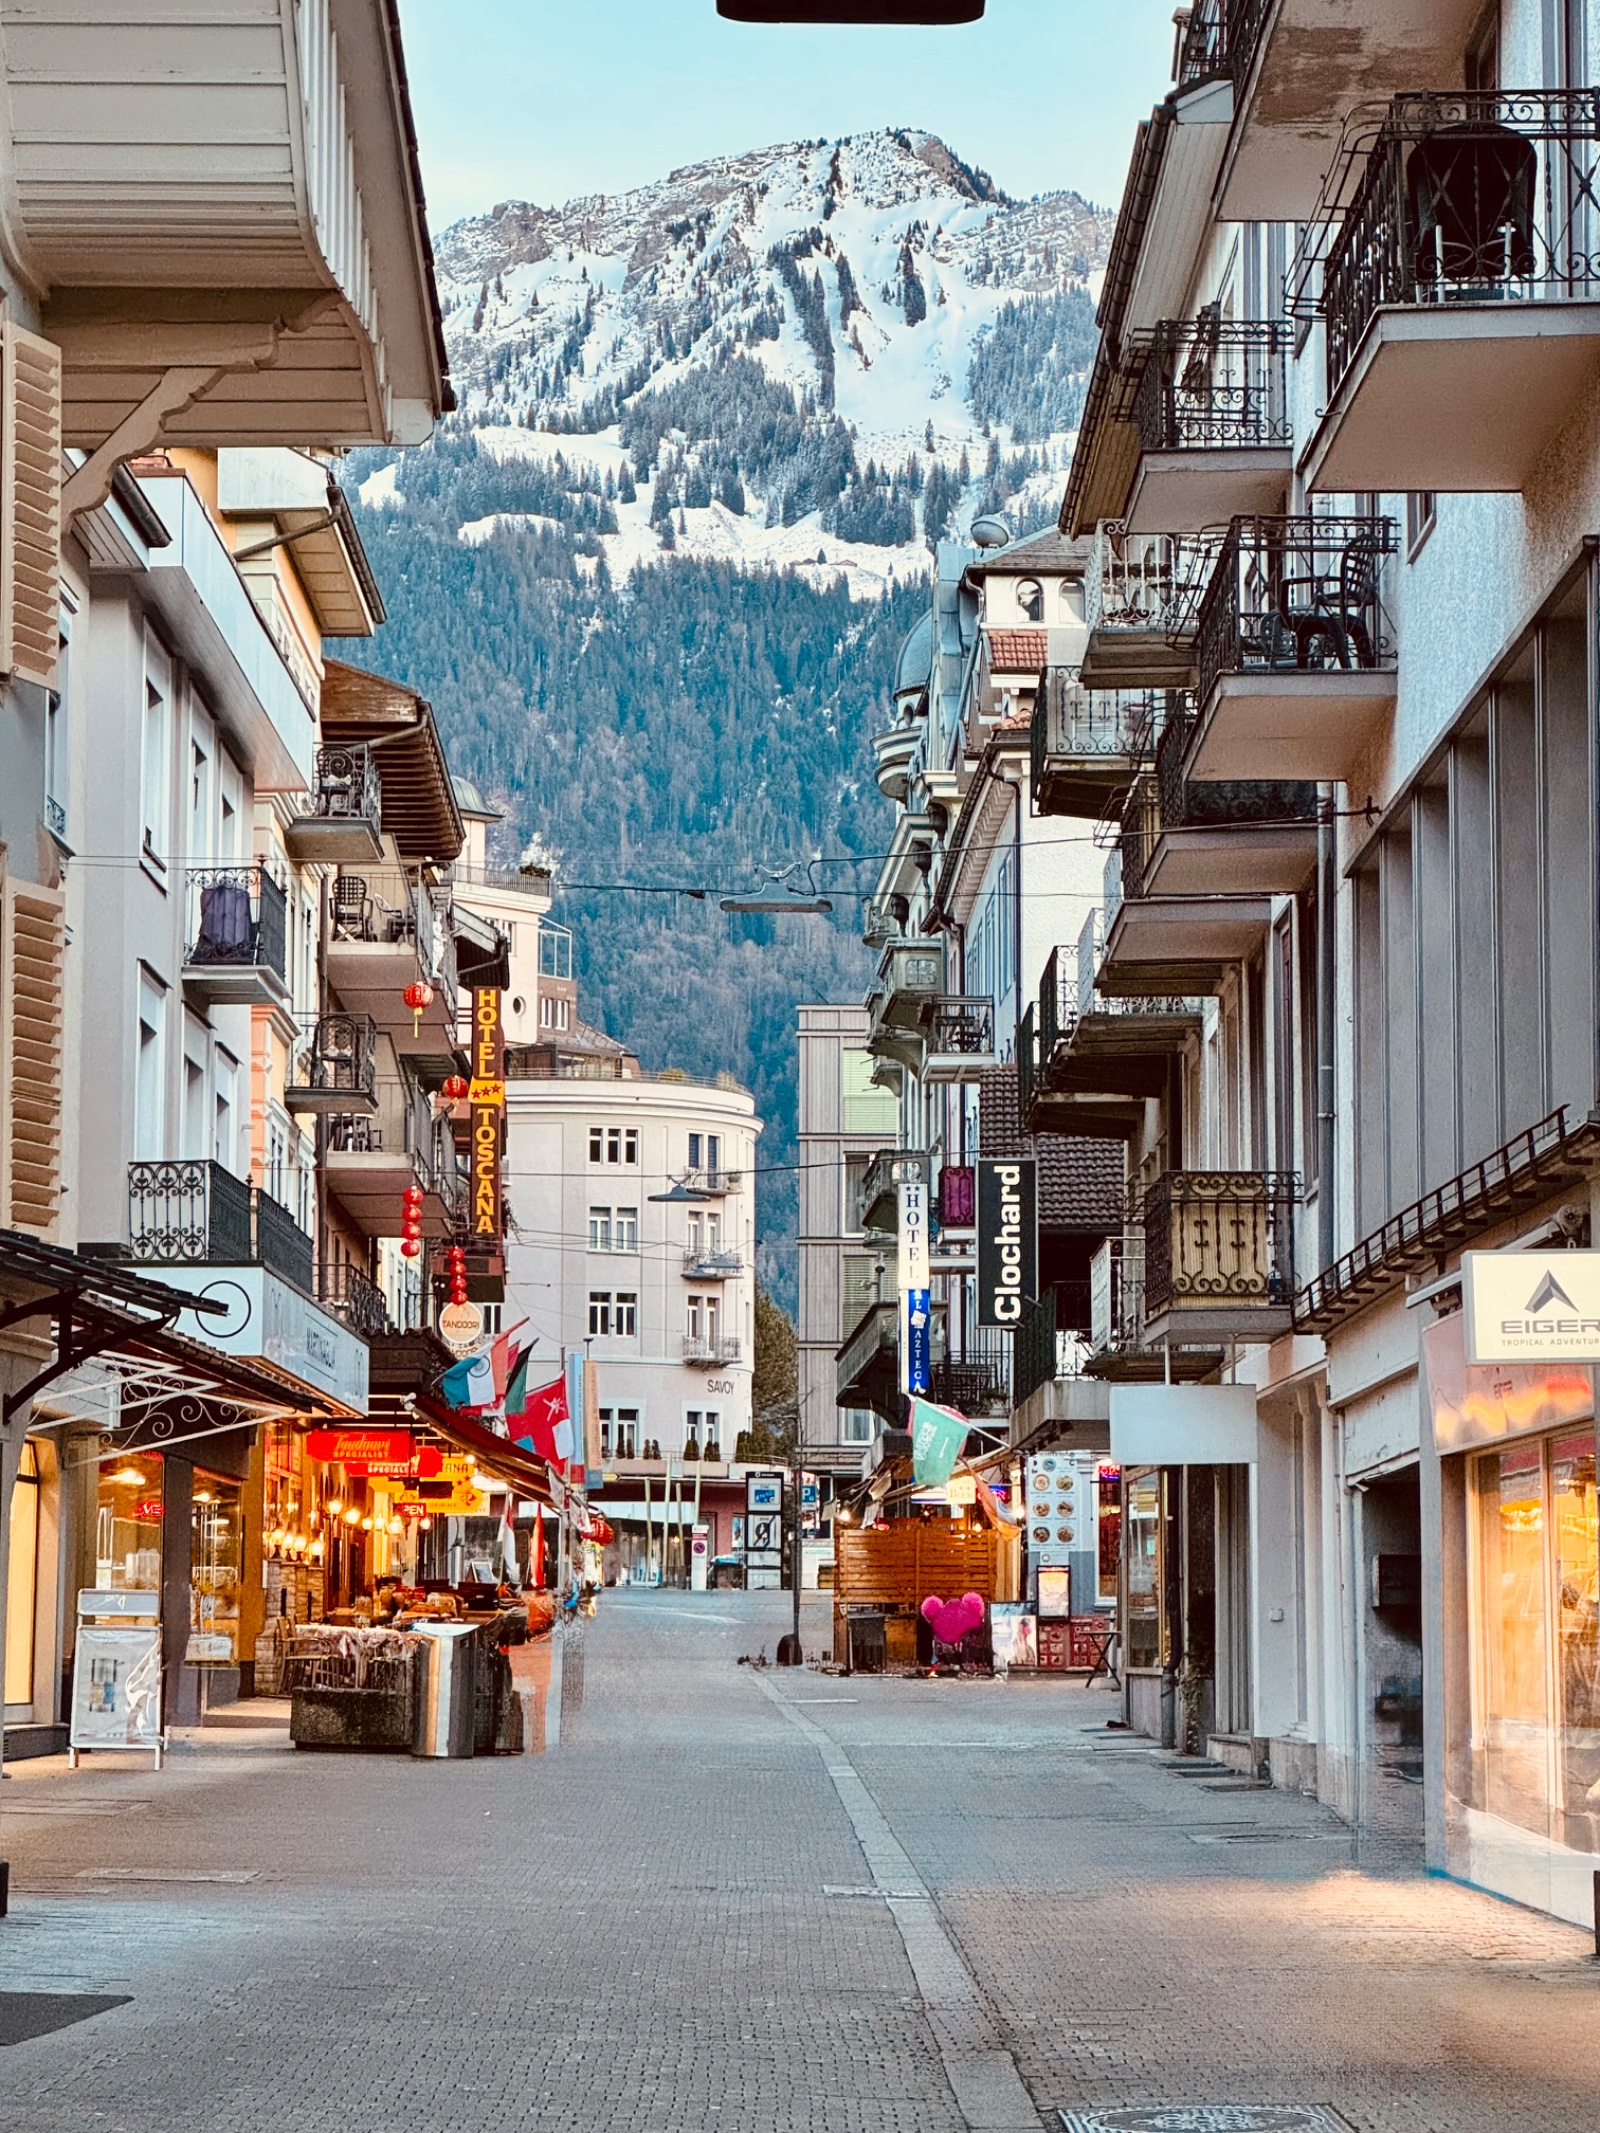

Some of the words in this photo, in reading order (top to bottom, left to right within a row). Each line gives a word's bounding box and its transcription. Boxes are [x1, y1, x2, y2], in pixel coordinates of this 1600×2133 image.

[477, 989, 498, 1078] HOTEL
[476, 1108, 497, 1234] TOSCANA
[906, 1194, 920, 1279] HOTEL
[994, 1165, 1021, 1321] Clochard
[442, 1319, 480, 1329] TANDOORI
[1501, 1319, 1600, 1334] EIGER
[1502, 1338, 1544, 1347] TROPICAL
[1550, 1338, 1600, 1346] ADVENTUR
[913, 1331, 922, 1392] AZTECA
[707, 1379, 735, 1395] SAVOY
[367, 1465, 419, 1474] SPECIALIT
